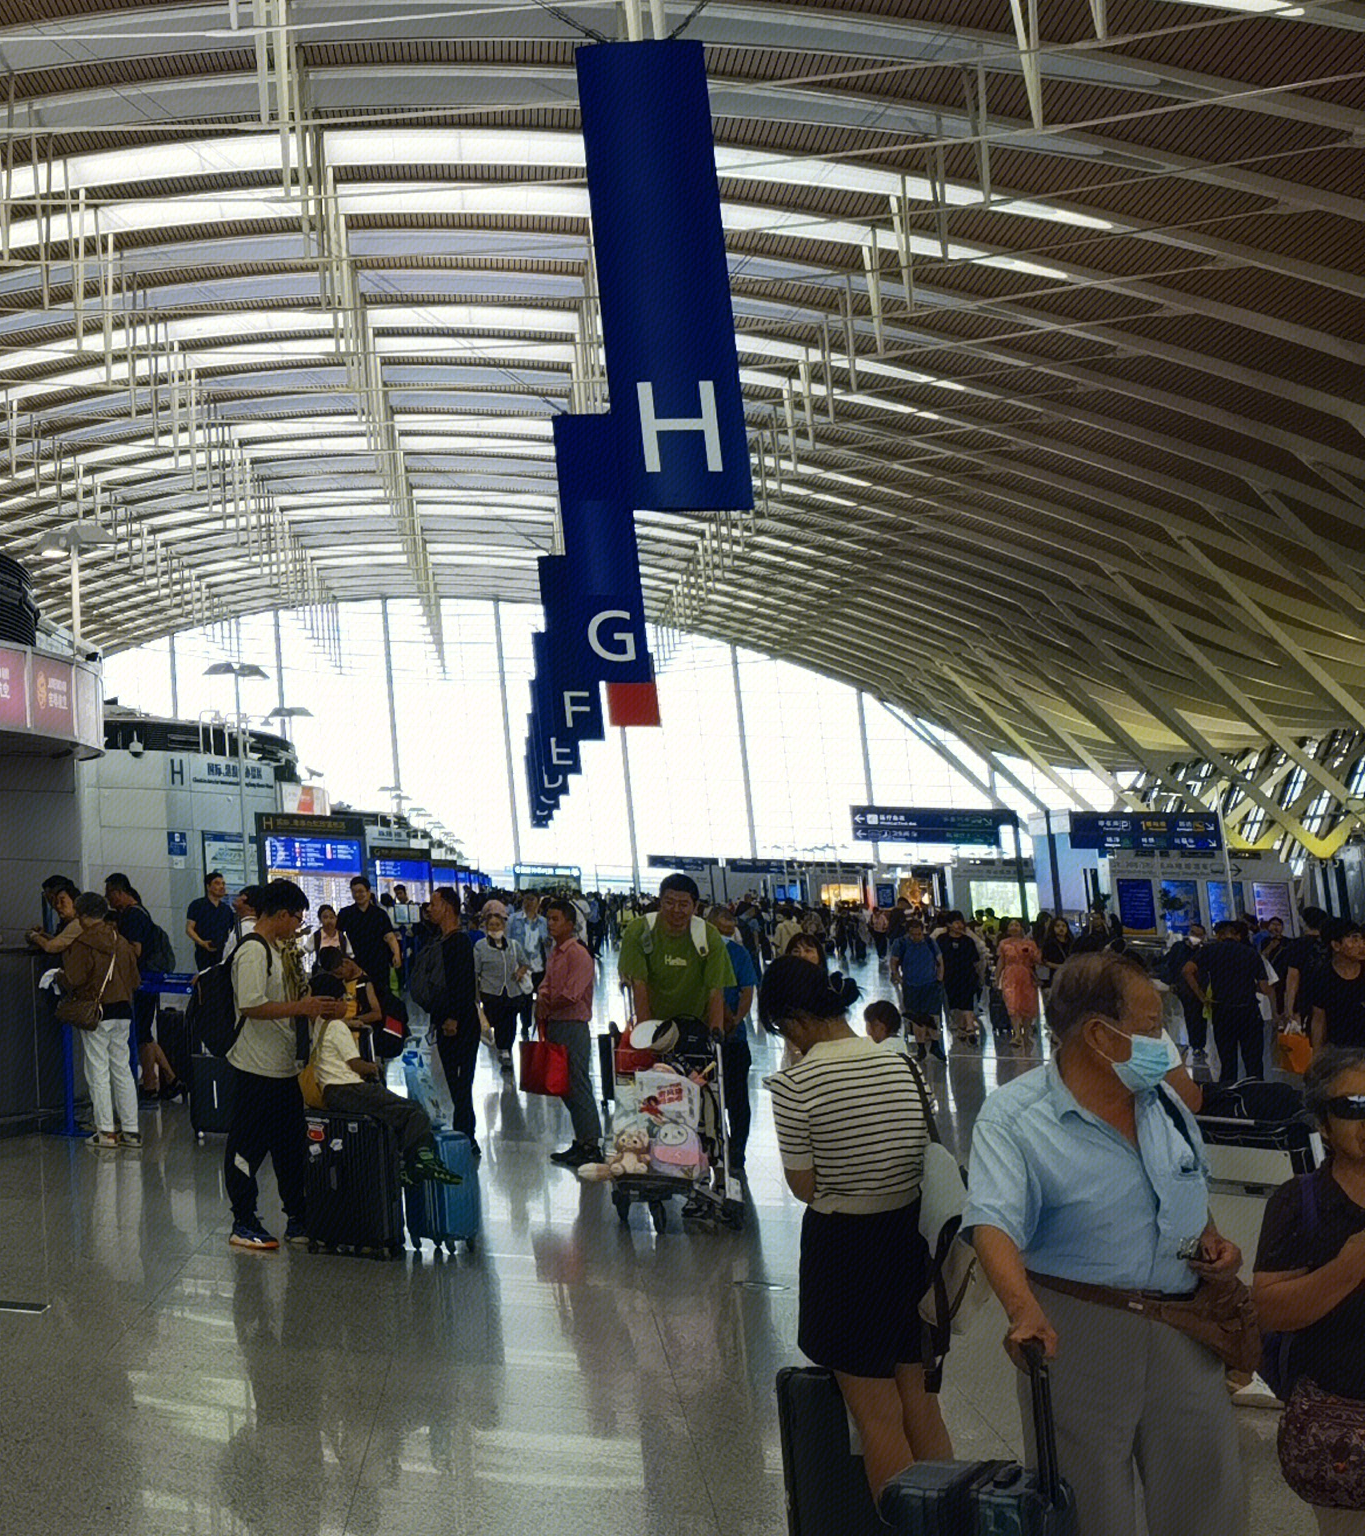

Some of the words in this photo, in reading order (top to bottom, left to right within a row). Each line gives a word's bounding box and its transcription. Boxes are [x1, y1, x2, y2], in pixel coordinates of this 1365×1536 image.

[636, 380, 723, 473] H
[587, 610, 636, 662] G
[563, 691, 590, 728] F
[170, 759, 184, 786] H
[262, 816, 273, 830] H
